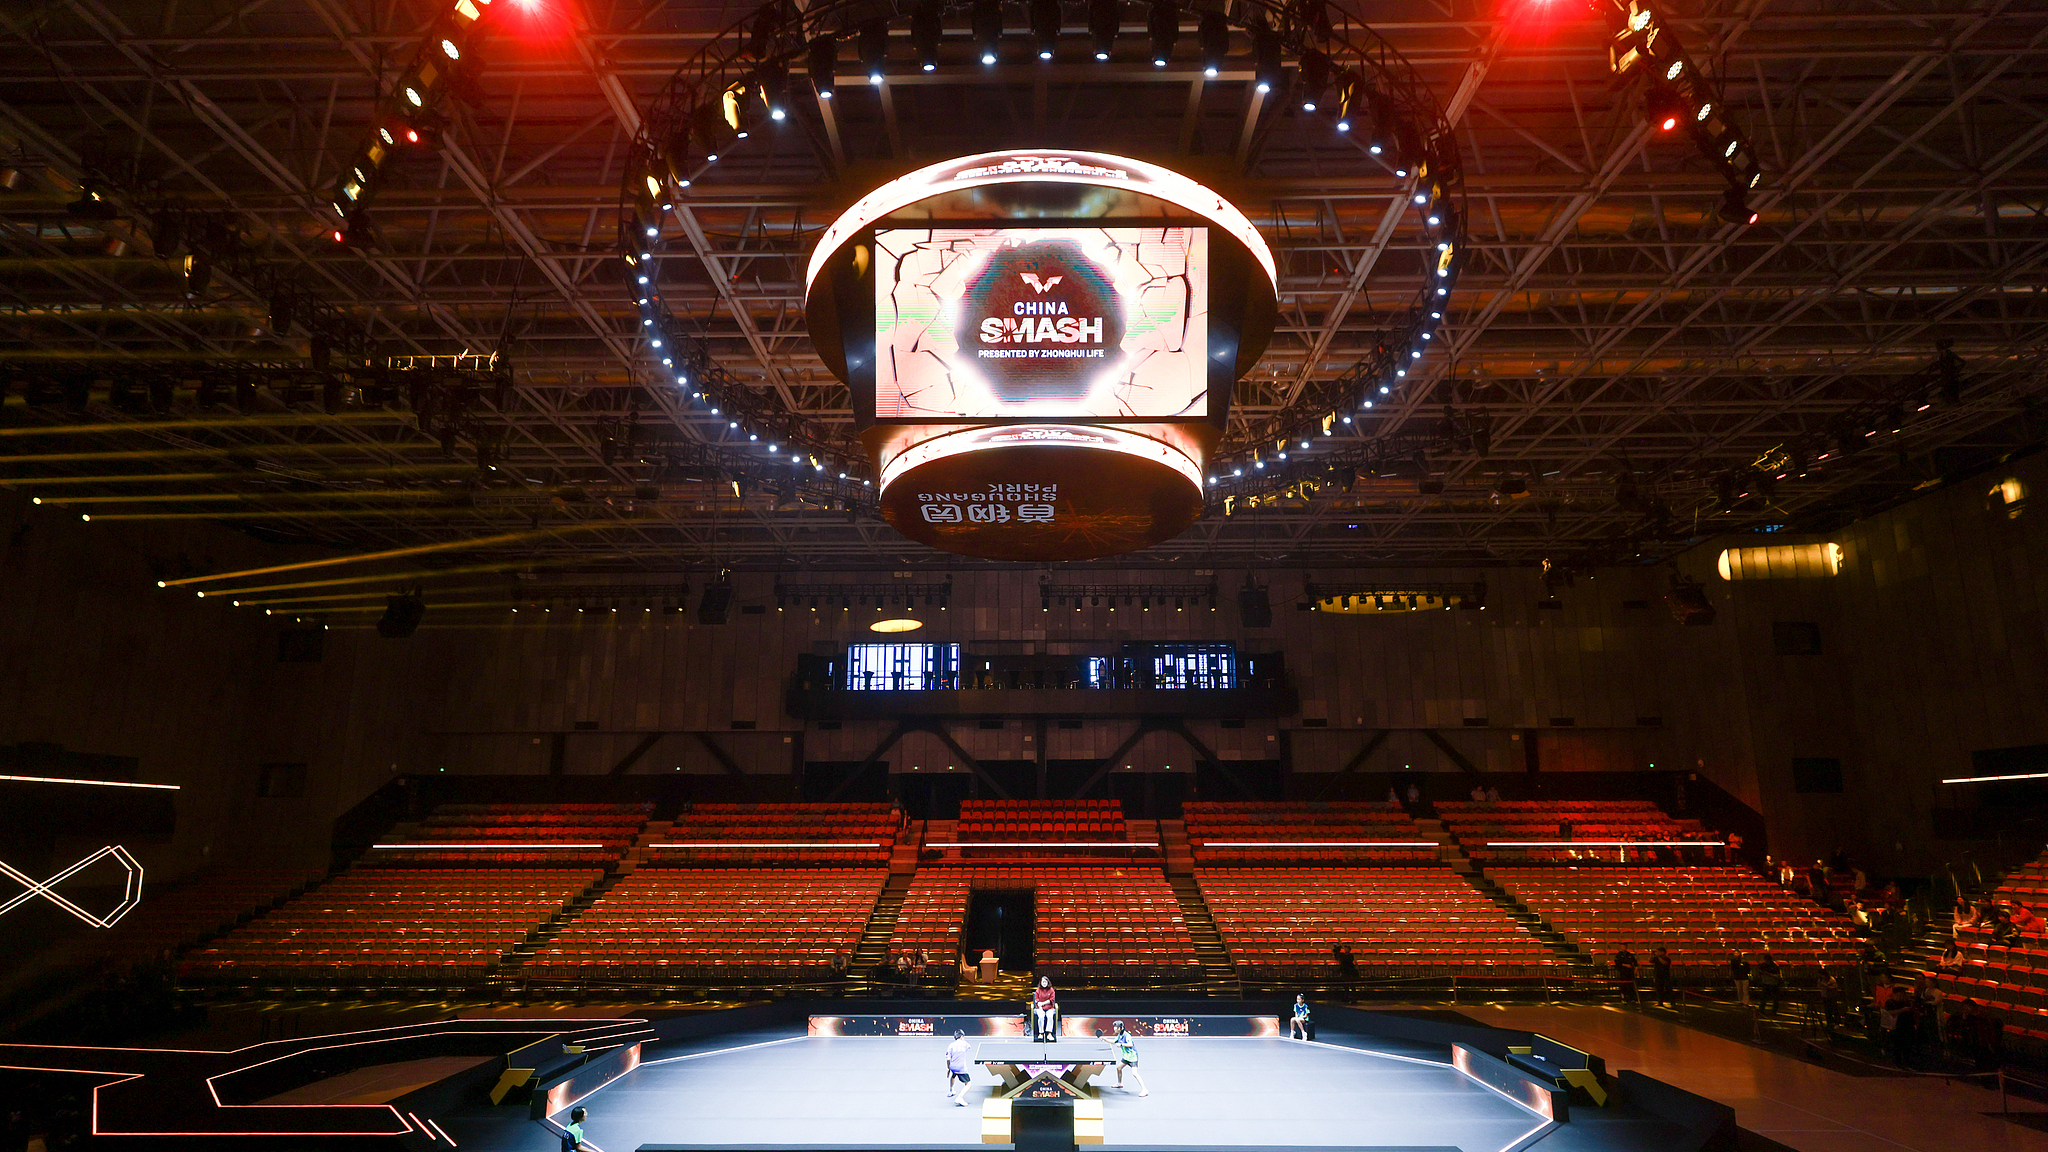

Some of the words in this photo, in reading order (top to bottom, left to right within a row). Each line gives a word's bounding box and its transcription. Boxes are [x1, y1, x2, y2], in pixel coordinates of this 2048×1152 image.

[1013, 301, 1069, 315] CHINA
[980, 317, 1103, 343] SMASH
[978, 349, 1027, 358] PRESENTED
[1028, 349, 1040, 358] BY
[1041, 349, 1085, 358] ZHONGHUI
[1086, 349, 1105, 358] LIFE
[987, 483, 1057, 493] PARK
[917, 493, 1057, 502] SHOUGANG
[920, 504, 1055, 523] 首钢园
[899, 1023, 934, 1032] SMASH
[1153, 1023, 1189, 1032] SMASH
